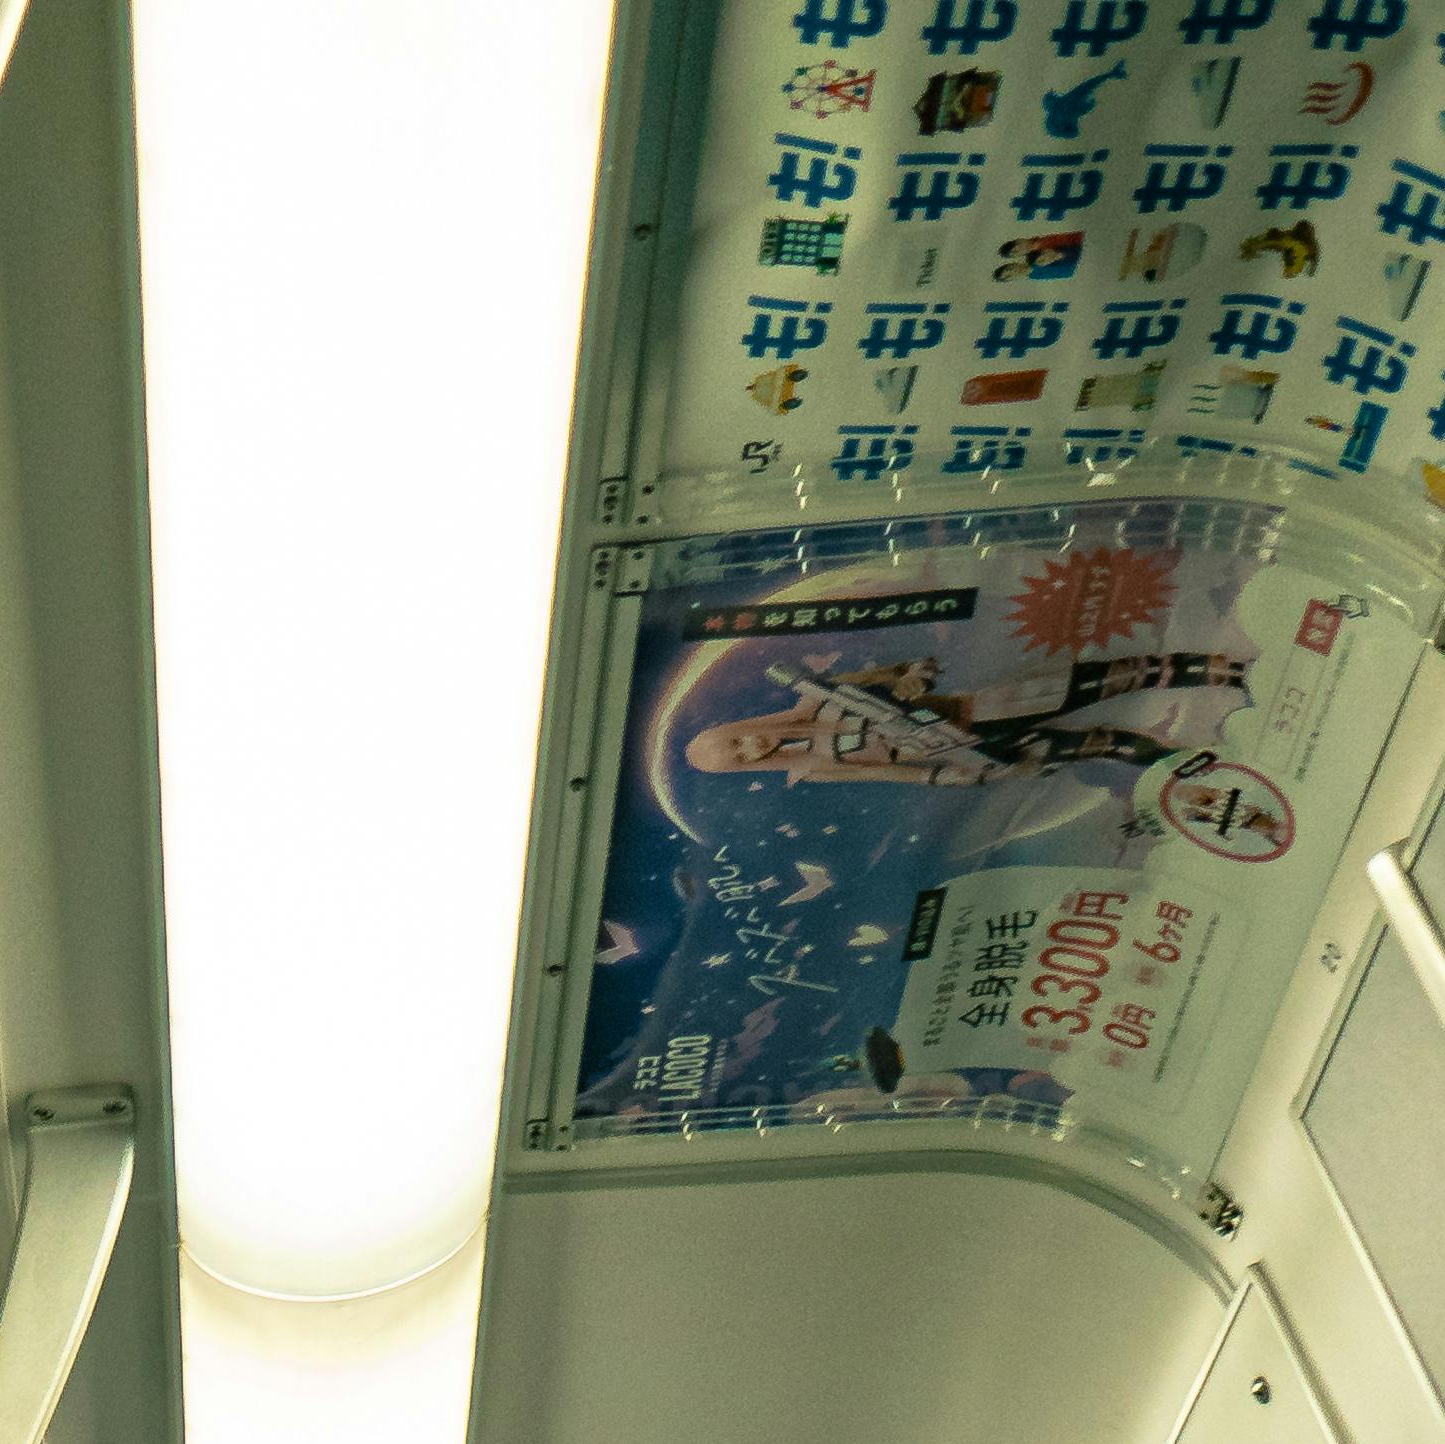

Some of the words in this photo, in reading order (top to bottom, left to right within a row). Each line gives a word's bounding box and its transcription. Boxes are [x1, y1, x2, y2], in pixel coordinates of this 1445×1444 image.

[959, 909, 1038, 1028] 全身脱毛
[659, 1034, 711, 1100] LACOCO
